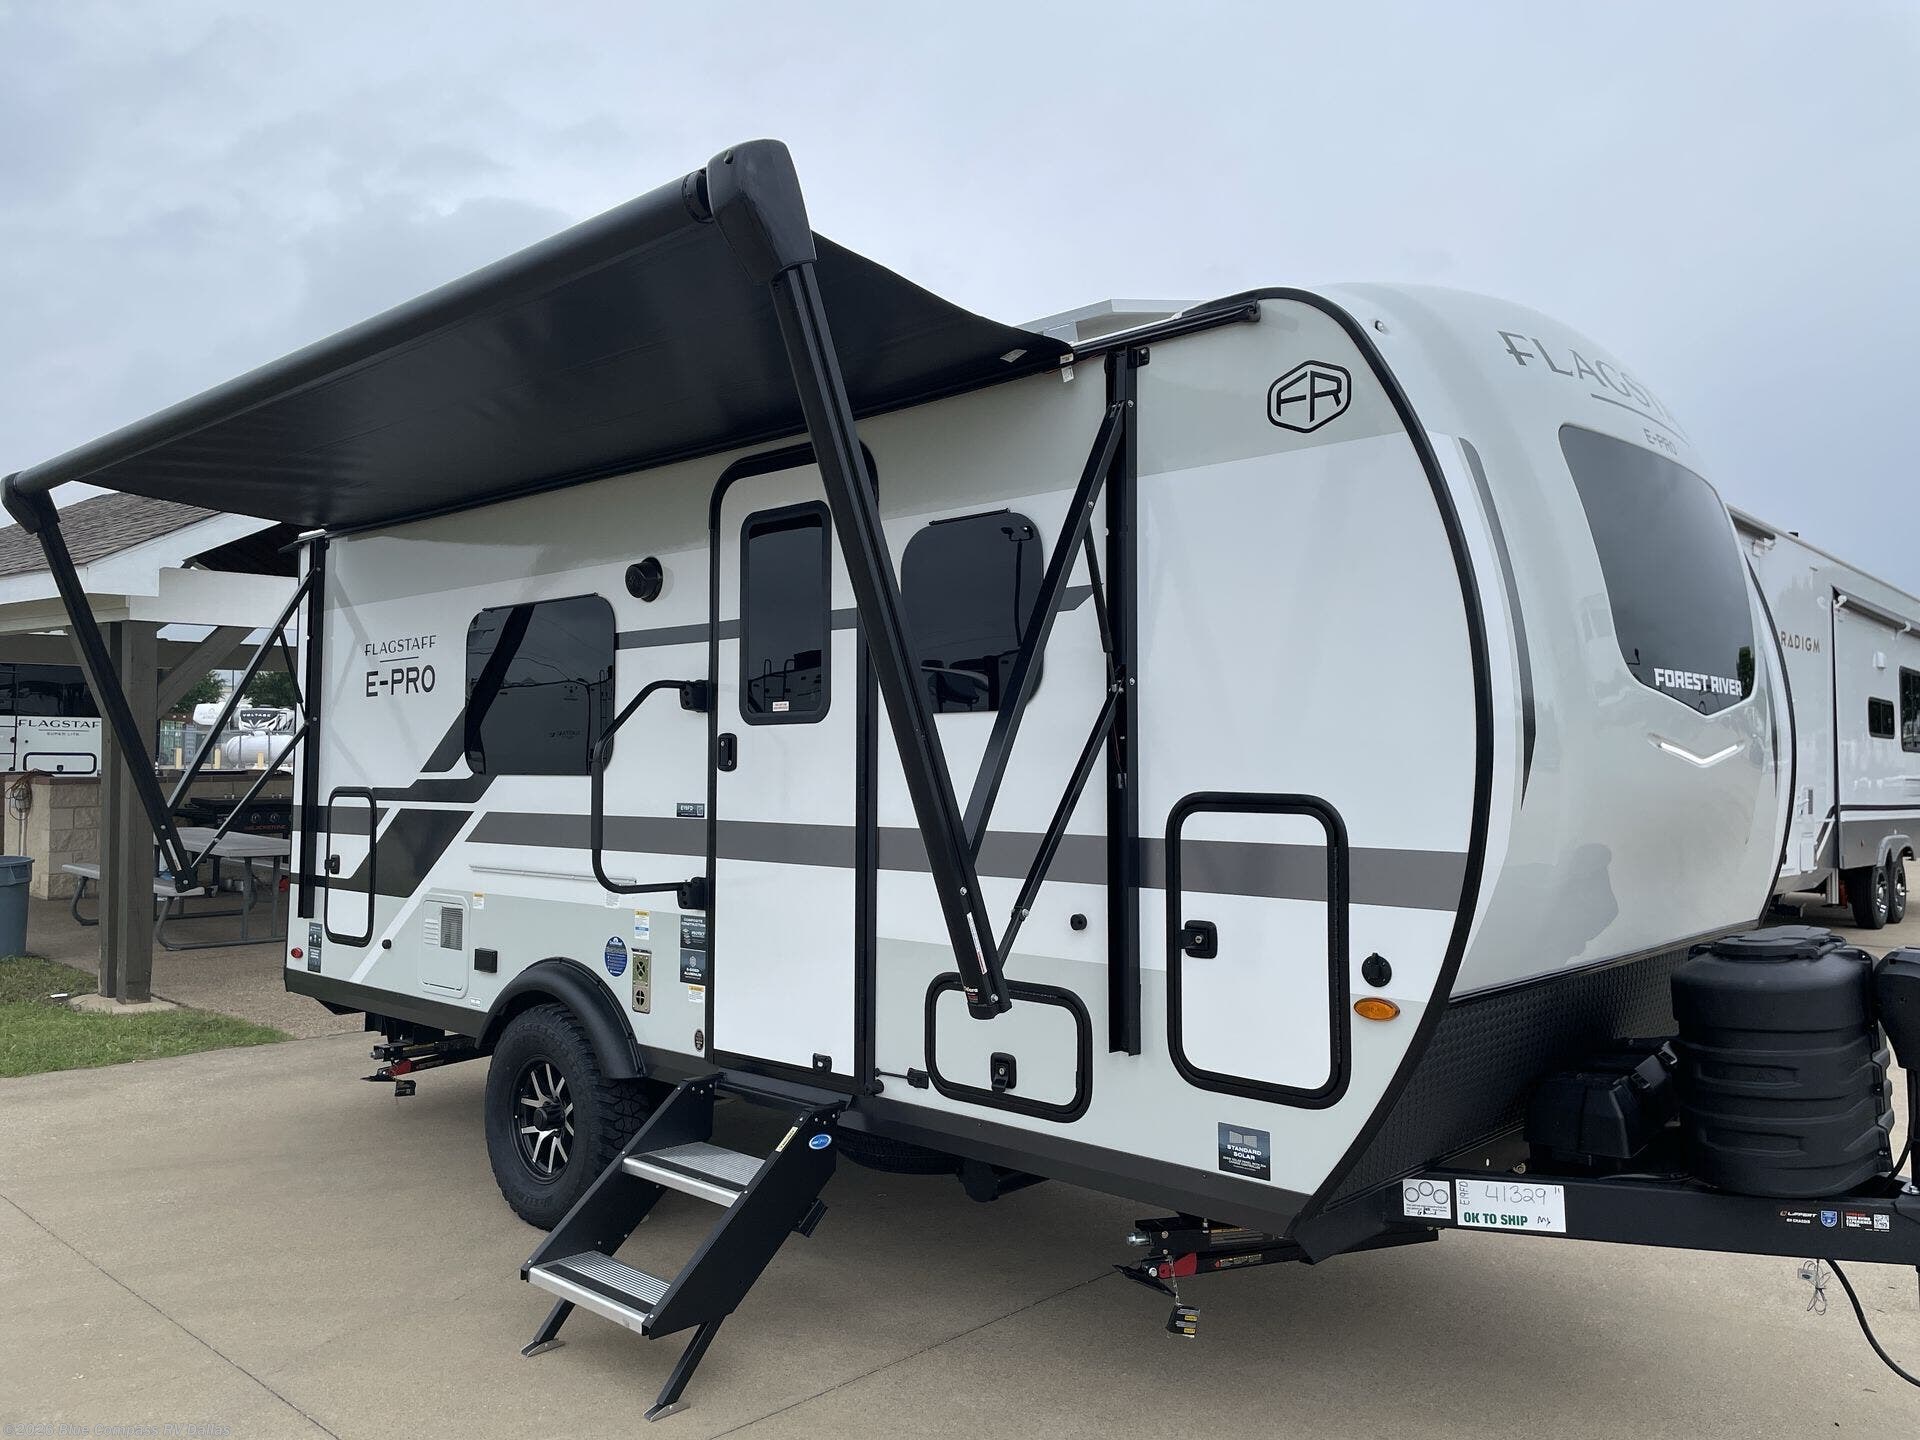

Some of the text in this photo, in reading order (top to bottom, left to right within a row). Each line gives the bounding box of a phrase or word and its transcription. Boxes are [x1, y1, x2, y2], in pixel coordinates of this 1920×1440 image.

[365, 634, 437, 656] FLAGSTAFF
[366, 664, 436, 698] E-PRO
[1653, 667, 1743, 697] FOREST RIVER
[1226, 1144, 1262, 1156] STANDARD
[1233, 1151, 1256, 1161] SOLAR
[1485, 1184, 1547, 1205] 41329
[1463, 1211, 1529, 1227] OK TO SHIP
